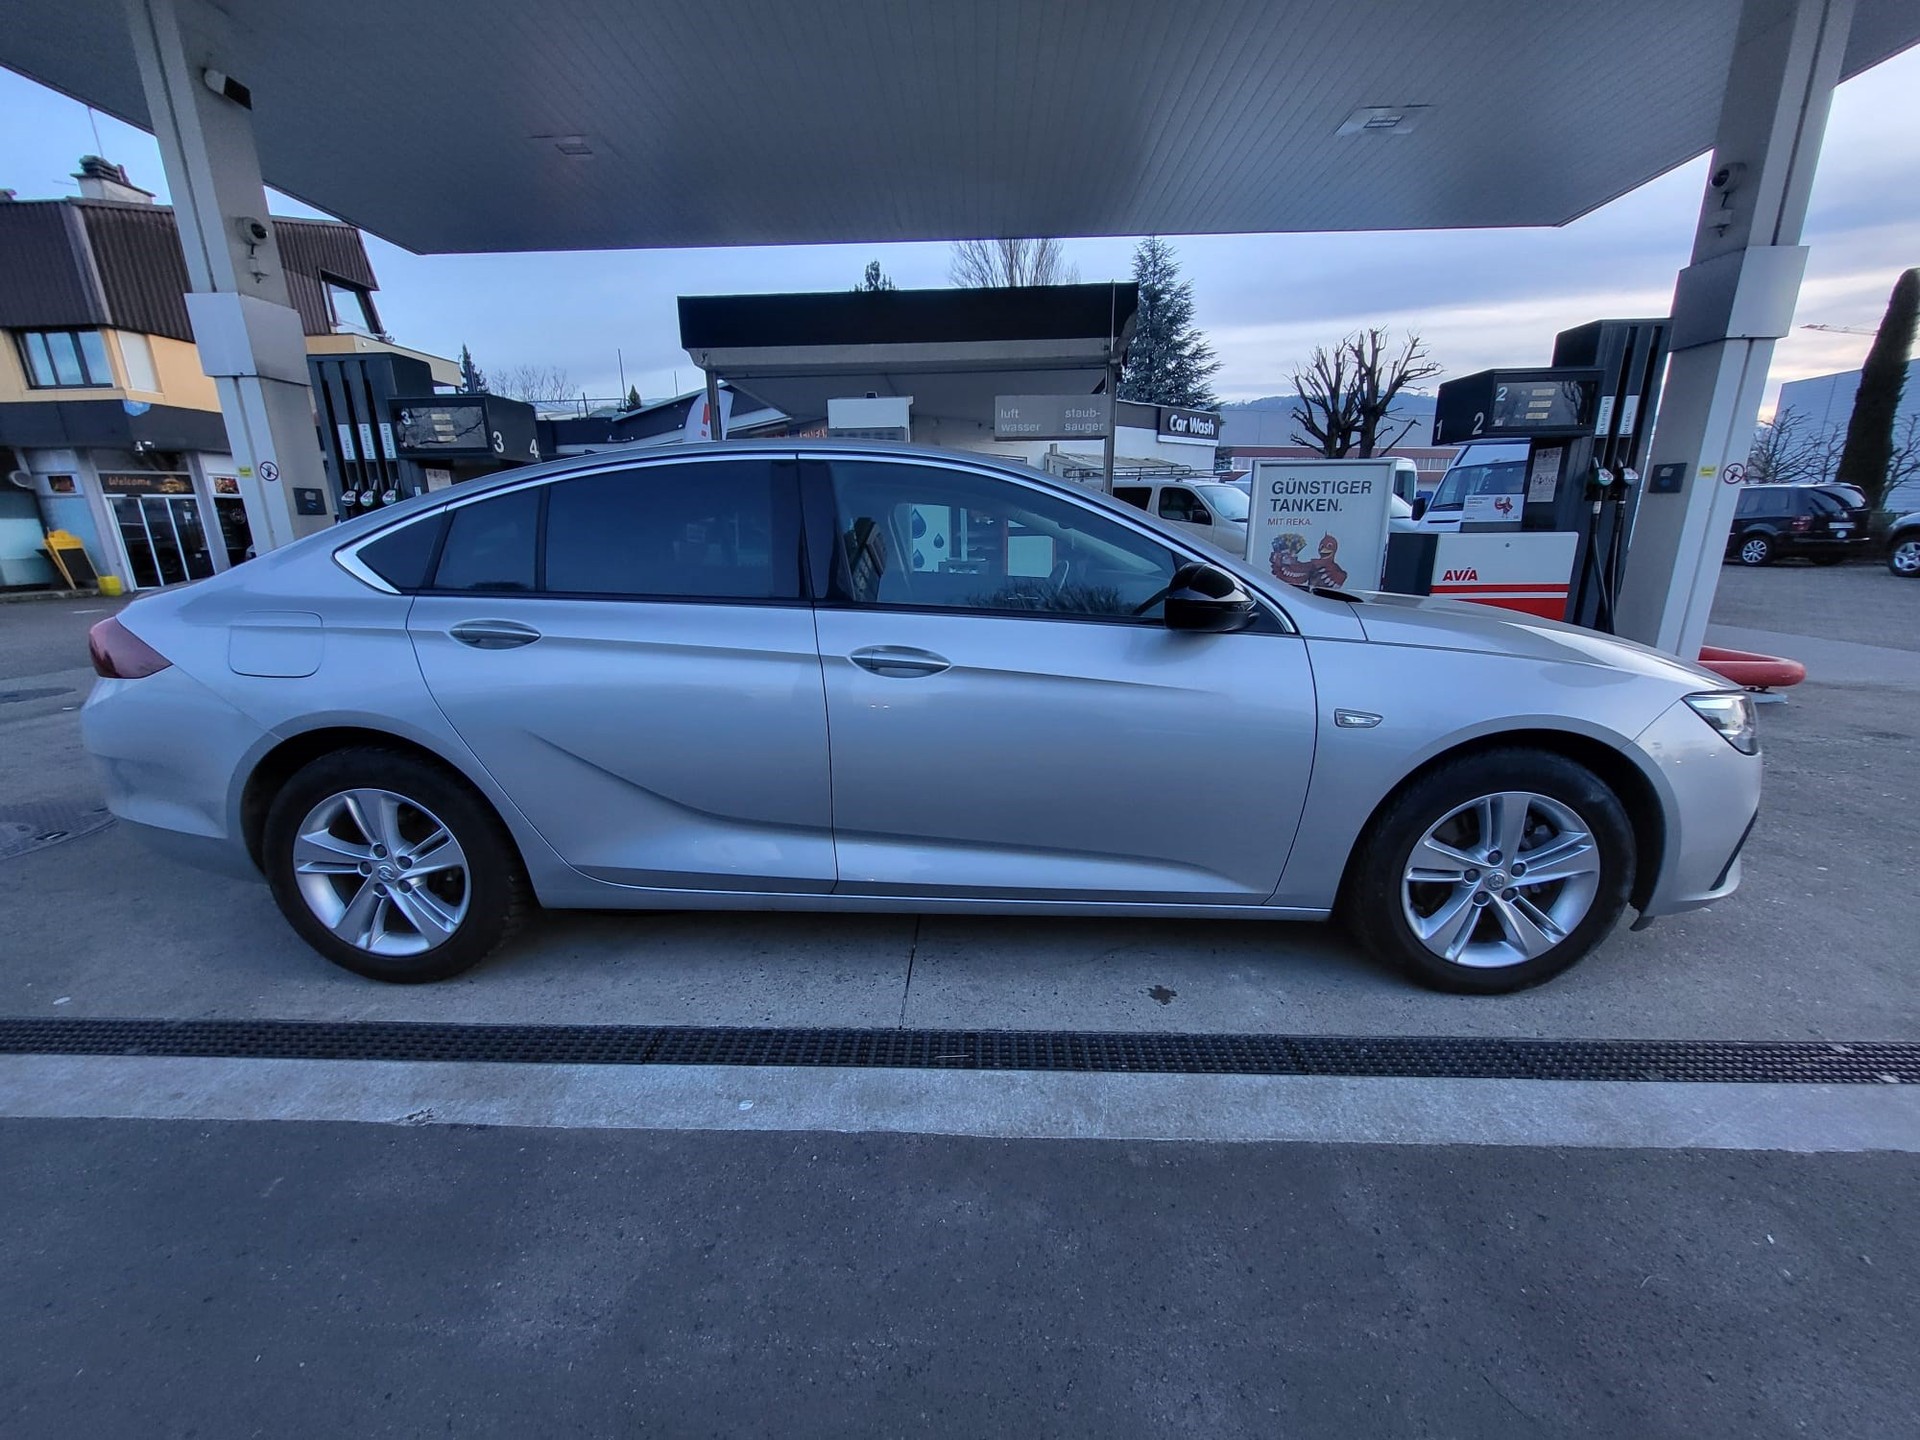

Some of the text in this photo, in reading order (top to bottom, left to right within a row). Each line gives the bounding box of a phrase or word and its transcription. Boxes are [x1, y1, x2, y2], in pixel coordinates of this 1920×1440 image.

[1496, 387, 1508, 401] 2
[401, 411, 411, 425] 3
[1000, 408, 1020, 418] luft
[1064, 408, 1102, 418] staub-
[1001, 422, 1041, 432] wasser
[1064, 422, 1104, 434] sauger
[1169, 414, 1215, 435] Car Wash
[1436, 419, 1443, 440] 1
[1471, 412, 1484, 435] 2
[492, 431, 505, 453] 3
[529, 438, 540, 459] 4
[108, 477, 151, 486] Welcome
[1271, 478, 1372, 494] GÜNSTIGER
[1270, 499, 1343, 512] TANKEN.
[1267, 518, 1283, 526] MIT
[1442, 567, 1478, 581] AVIA
